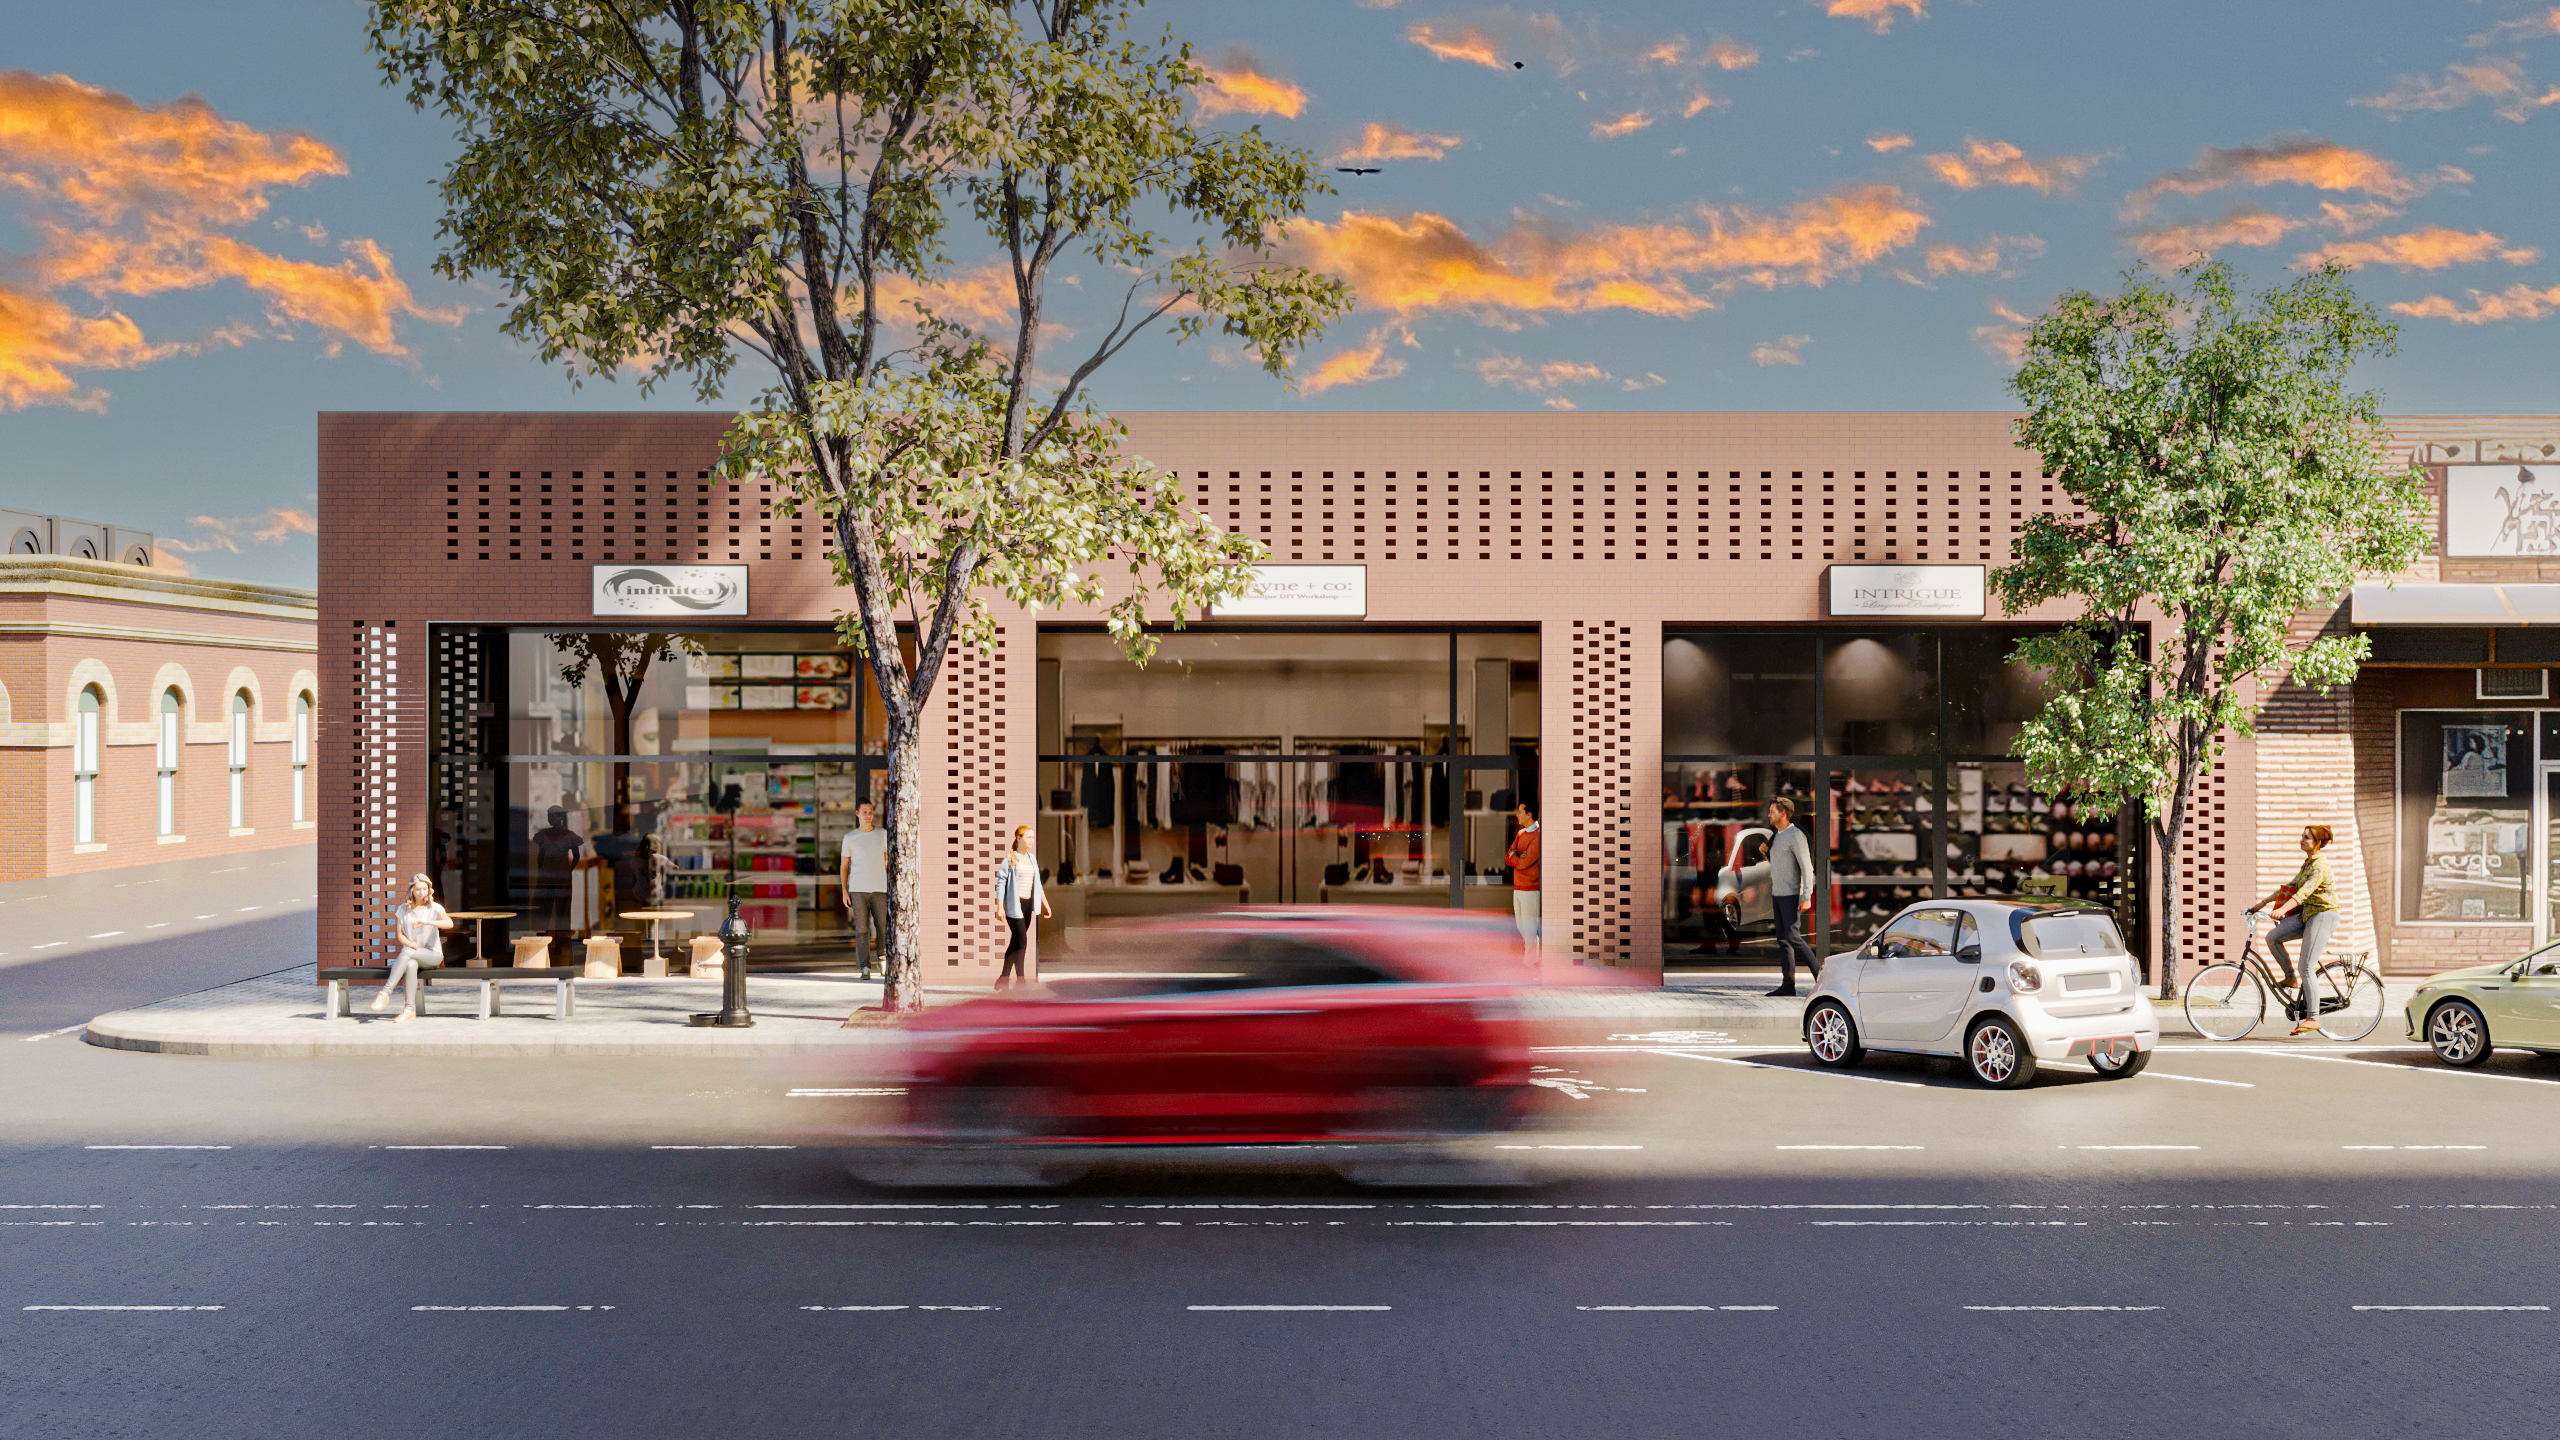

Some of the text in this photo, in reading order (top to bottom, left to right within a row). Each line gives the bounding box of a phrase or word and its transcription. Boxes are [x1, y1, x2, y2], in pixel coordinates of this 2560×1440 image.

[627, 585, 714, 595] infinitea
[1854, 589, 1962, 600] INTRIGUE
[1861, 600, 1955, 610] Lingerie Boutique
